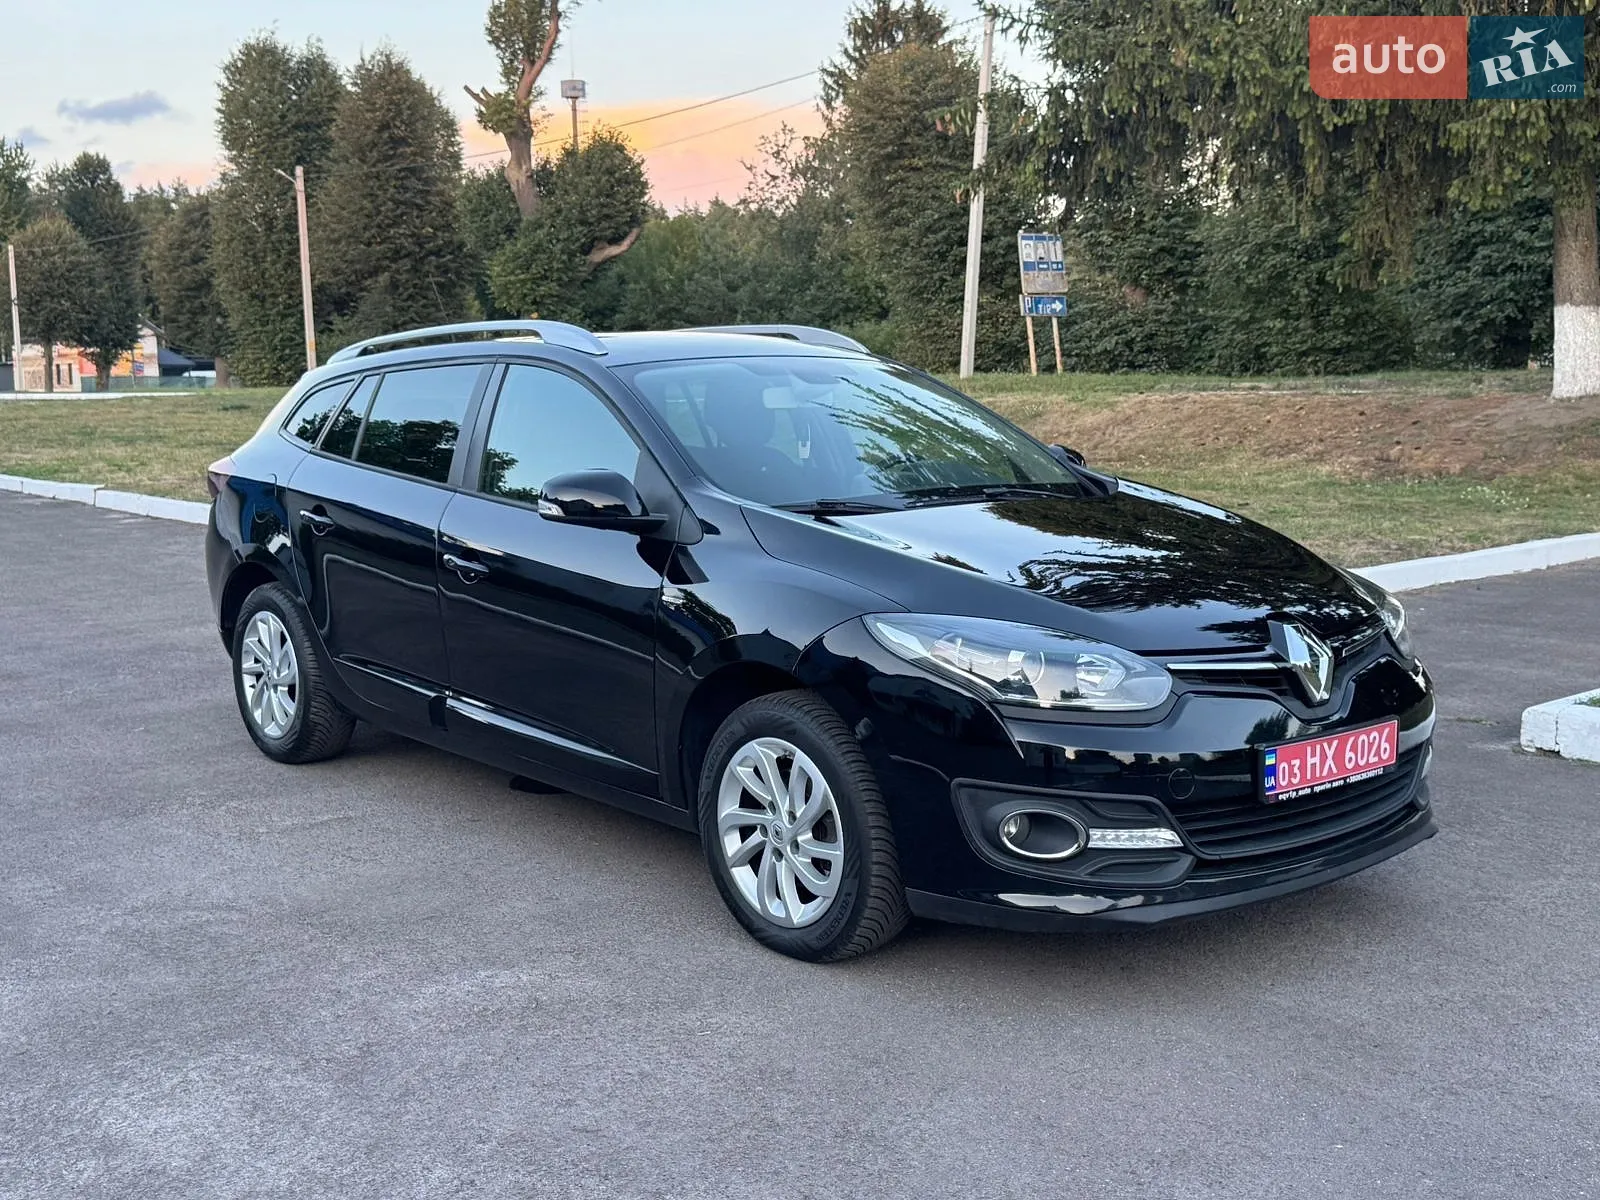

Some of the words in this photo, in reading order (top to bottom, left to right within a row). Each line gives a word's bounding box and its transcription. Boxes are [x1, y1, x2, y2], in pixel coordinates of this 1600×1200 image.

[1279, 758, 1301, 787] 03
[1344, 727, 1390, 770] 6026
[1265, 776, 1276, 788] UA
